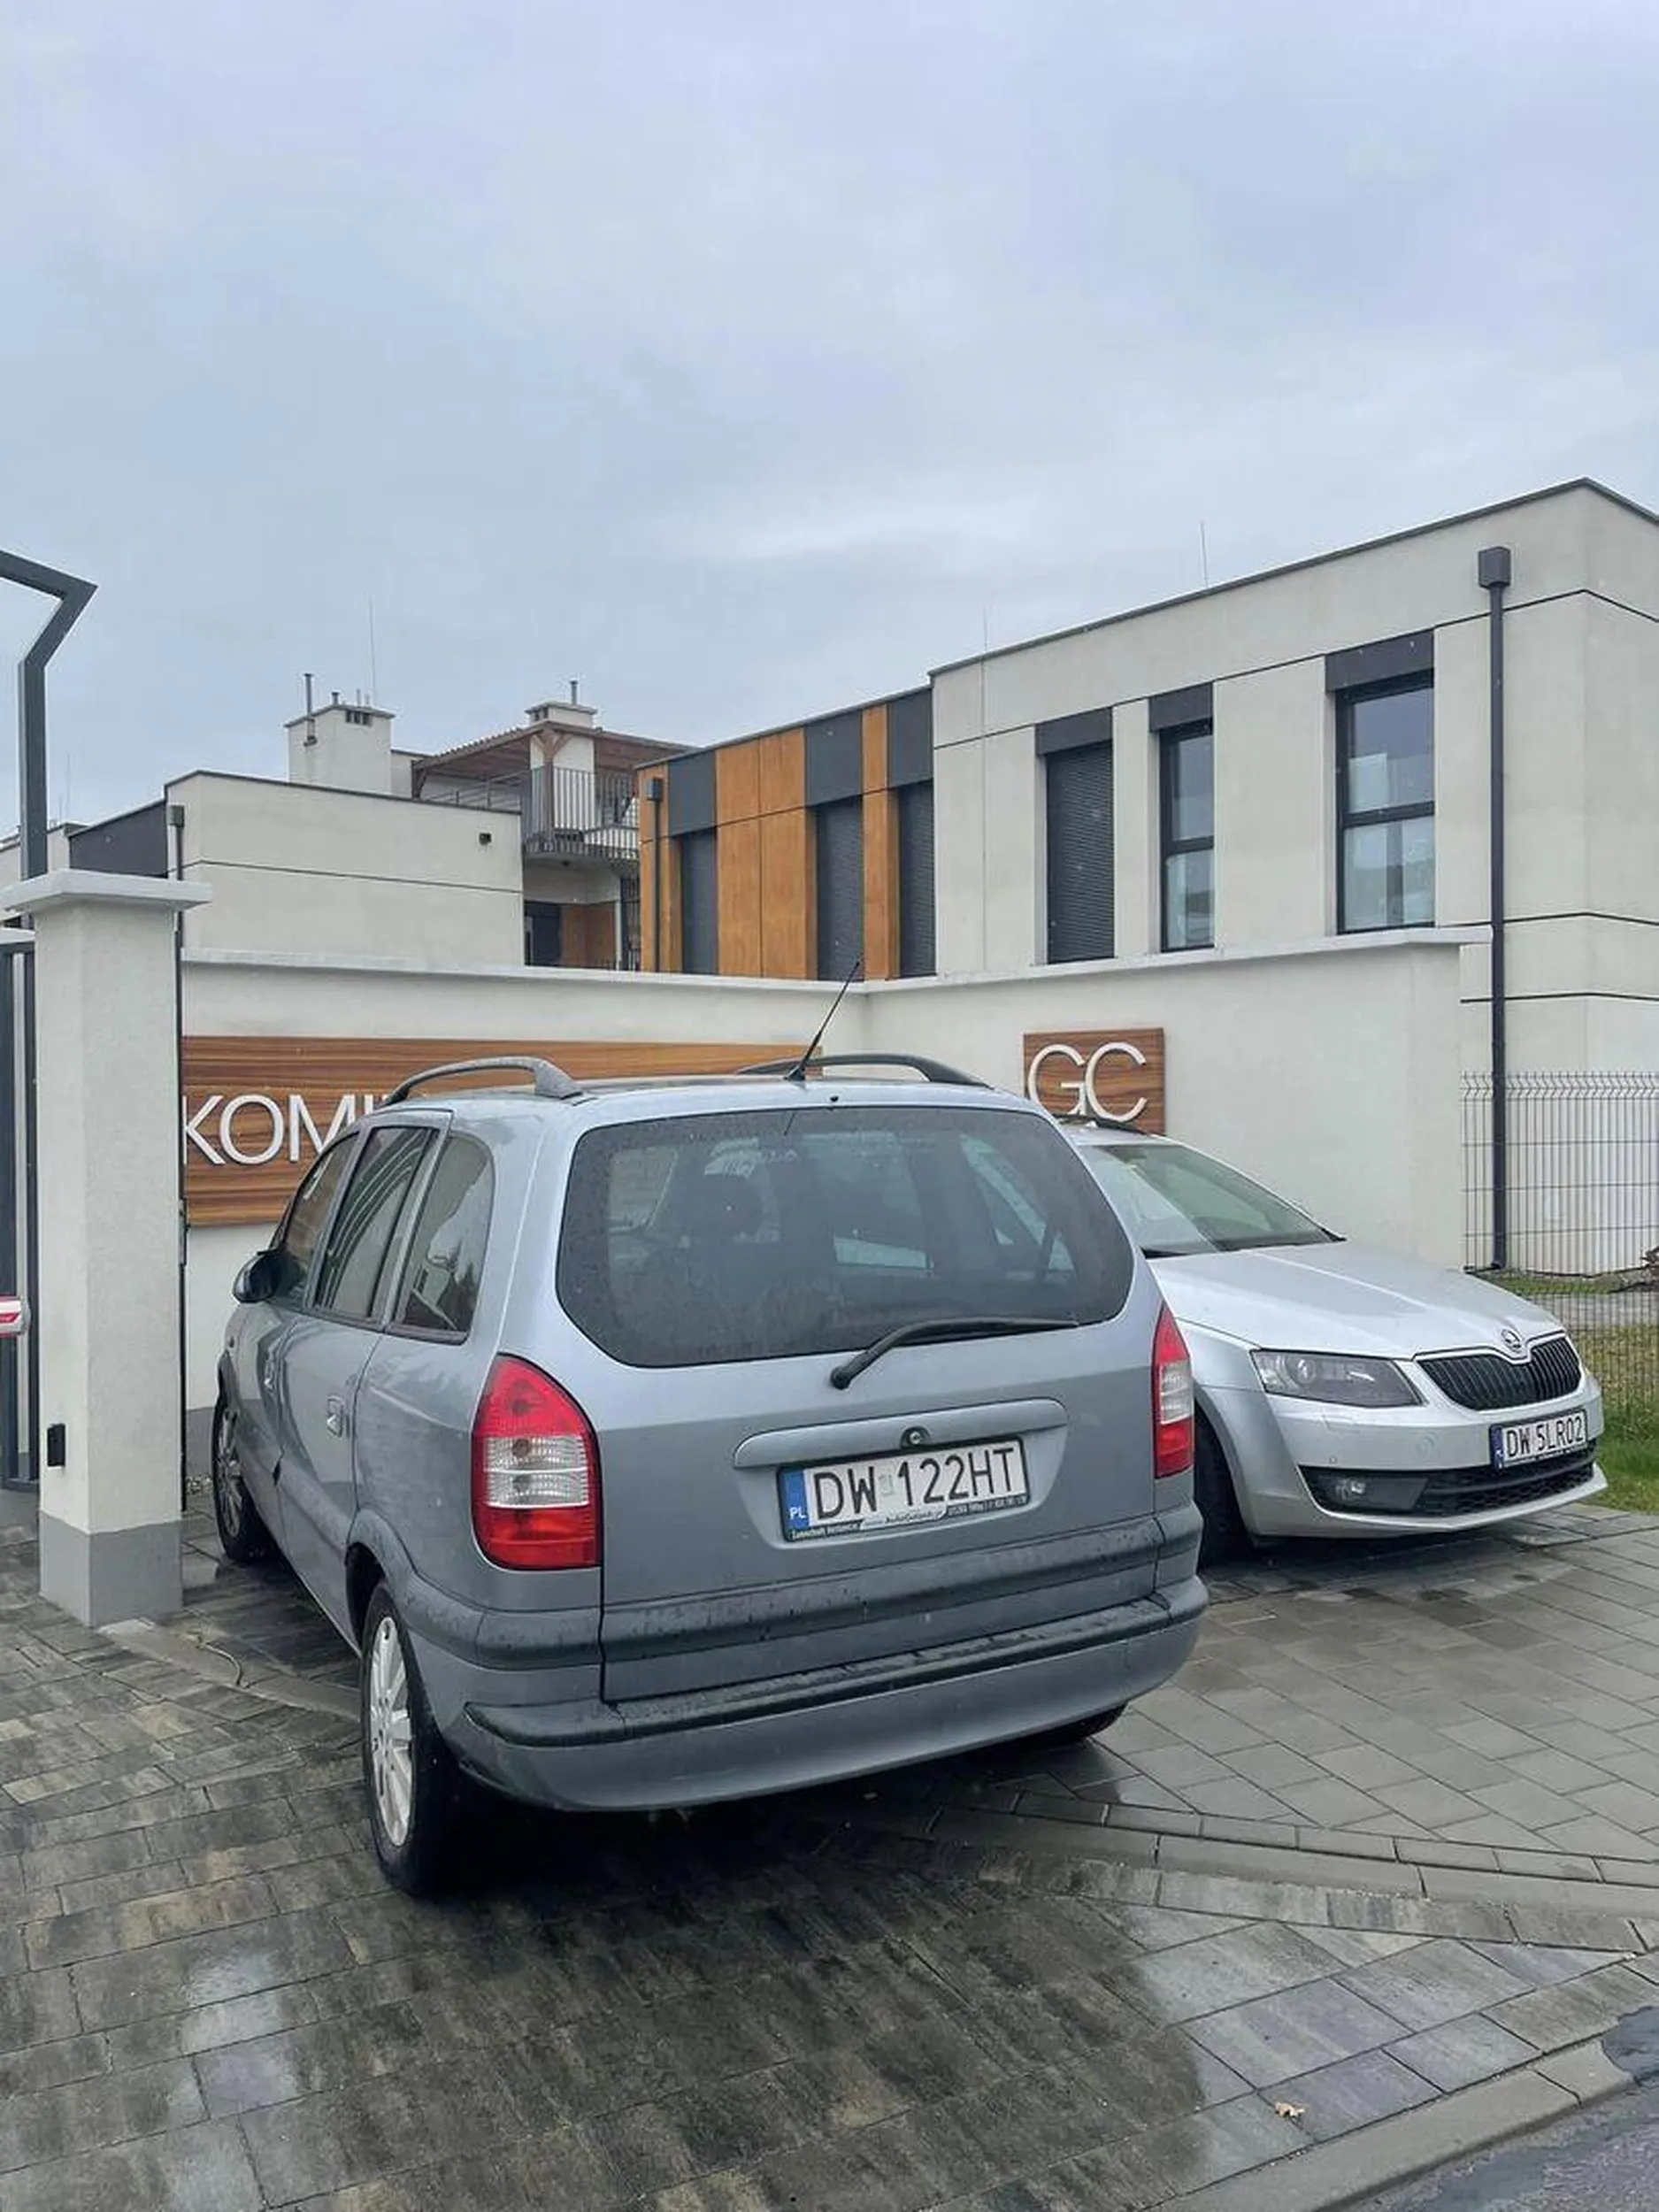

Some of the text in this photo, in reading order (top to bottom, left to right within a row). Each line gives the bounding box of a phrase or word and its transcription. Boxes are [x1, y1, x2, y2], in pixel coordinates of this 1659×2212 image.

[1028, 1042, 1148, 1122] GC
[1507, 1428, 1530, 1457] DW
[813, 1448, 1014, 1520] DW 122HT
[789, 1507, 807, 1519] PL
